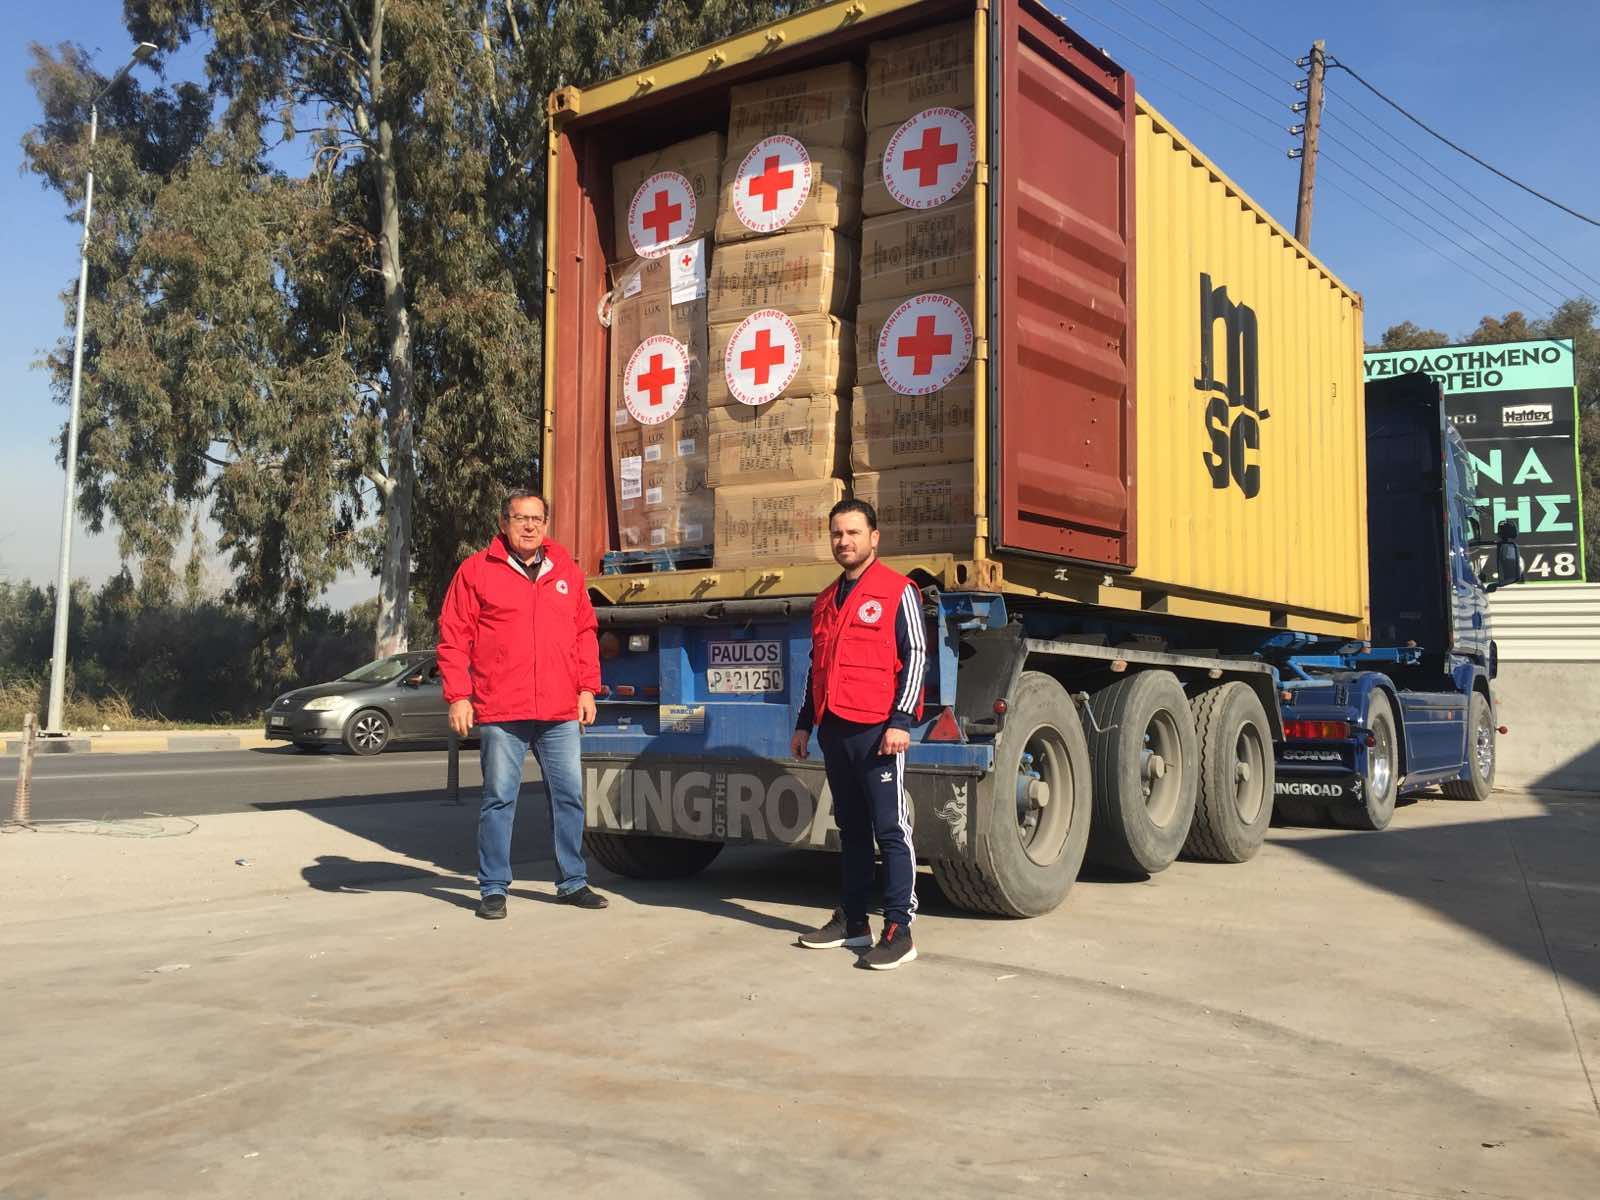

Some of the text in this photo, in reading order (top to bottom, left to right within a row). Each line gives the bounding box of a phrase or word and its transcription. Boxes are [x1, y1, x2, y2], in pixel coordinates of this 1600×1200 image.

[885, 117, 918, 163] ΕΛΛΗΝΙΚΟΣ
[885, 160, 975, 208] HELLENIC RED CROSS
[734, 199, 766, 231] HELLENIC
[789, 186, 809, 217] CROSS
[879, 295, 972, 348] ΕΛΛΗΝΙΚΟΣ ΕΡΥΘΡΟΣ ΣΤΑΥΡΟΣ
[879, 355, 969, 394] HELLENIC RED CROSS
[1364, 347, 1561, 377] ΥΣΙΟΔΟΤΗΜΕΝΟ
[1431, 370, 1503, 391] ΡΓΕΙΟ
[726, 373, 755, 404] HELLENIC
[758, 392, 775, 403] RED
[777, 362, 799, 391] CROSS
[1504, 410, 1550, 422] Haldex
[712, 644, 778, 662] PAULOS
[586, 767, 713, 837] KING
[715, 771, 727, 808] THE
[1273, 783, 1343, 797] ING ROAD
[715, 807, 727, 838] OF
